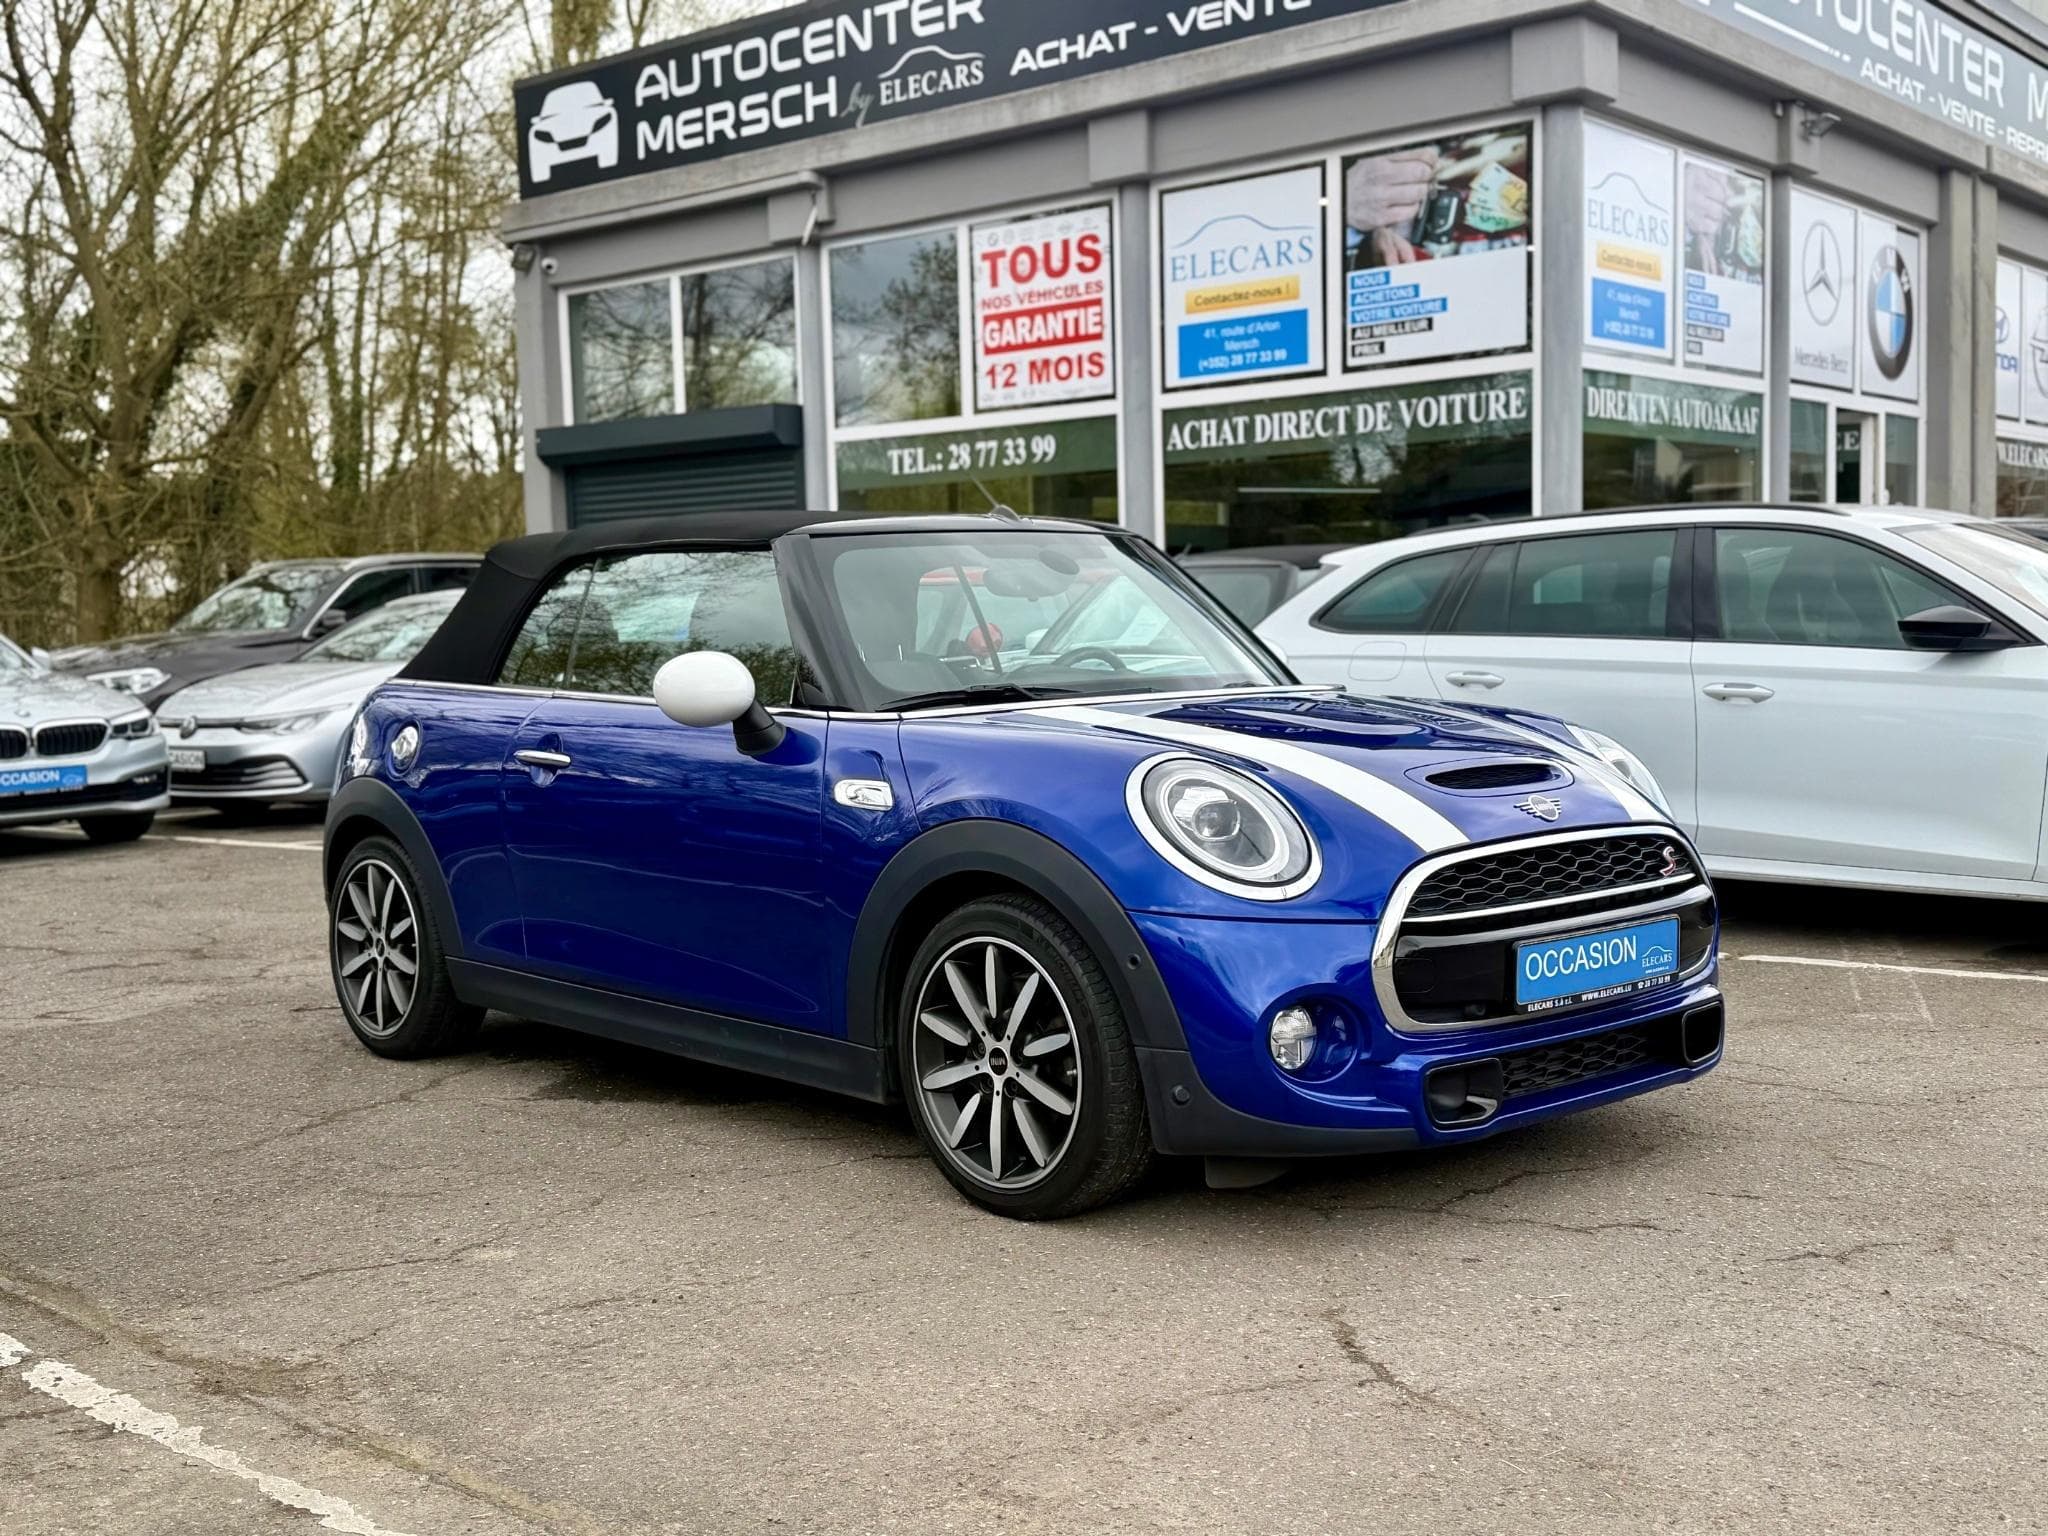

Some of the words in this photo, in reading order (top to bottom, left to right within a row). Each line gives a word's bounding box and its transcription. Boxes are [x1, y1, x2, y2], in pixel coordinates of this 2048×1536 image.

[635, 0, 985, 107] AUTOCENTER
[1009, 22, 1136, 76] ACHAT
[637, 75, 837, 160] MERSCH
[840, 81, 874, 128] by
[879, 60, 985, 106] ELECARS
[1860, 57, 1925, 104] ACHAT
[1938, 92, 1996, 138] VENTE
[1587, 198, 1670, 247] ELECARS
[981, 233, 1102, 288] TOUS
[1171, 236, 1313, 282] ELECARS
[981, 295, 1012, 309] NOS
[984, 304, 1102, 350] GARANTIE
[986, 363, 1016, 389] 12
[1029, 352, 1105, 385] MOIS
[1166, 415, 1249, 450] ACHAT
[1254, 405, 1350, 443] DIRECT
[1355, 401, 1392, 433] DE
[1398, 388, 1528, 428] VOITURE
[1587, 386, 1671, 425] DIREKTEN
[1671, 397, 1760, 435] AUTOAKAAF
[887, 447, 943, 475] TEL.:
[948, 442, 971, 470] 28
[975, 440, 998, 468] 77
[1003, 437, 1027, 466] 33
[1030, 434, 1056, 463] 99
[0, 769, 60, 787] CCASION
[1525, 935, 1637, 980] OCCASION
[1642, 952, 1673, 968] ELECARS
[1527, 998, 1554, 1012] ELECARS
[1581, 984, 1632, 1001] WWW.ELECARS.LU
